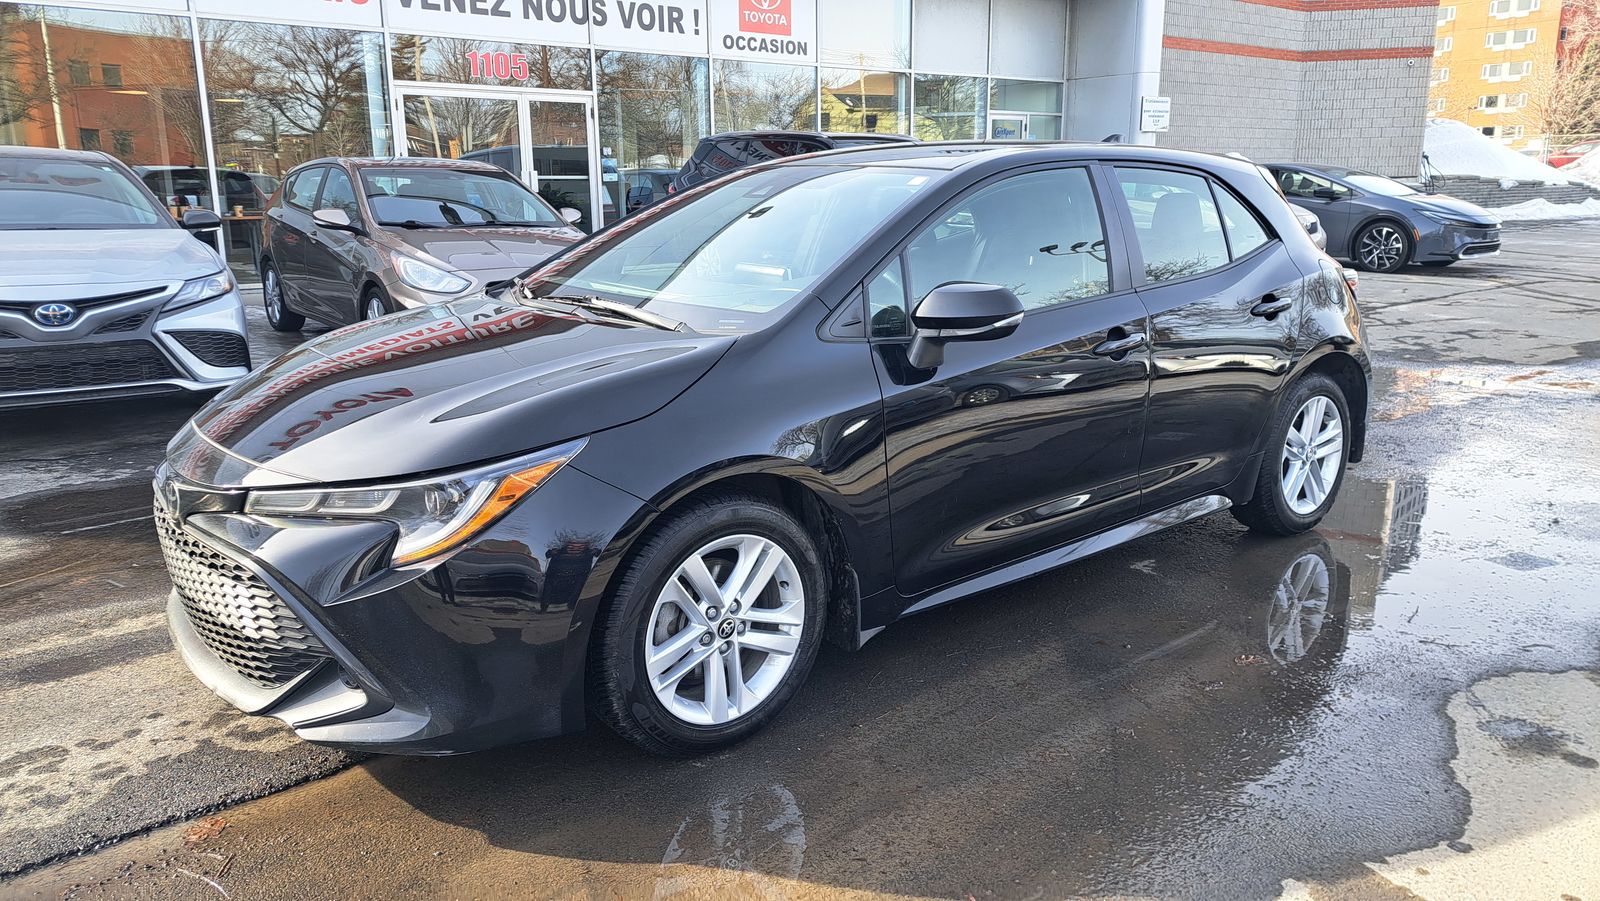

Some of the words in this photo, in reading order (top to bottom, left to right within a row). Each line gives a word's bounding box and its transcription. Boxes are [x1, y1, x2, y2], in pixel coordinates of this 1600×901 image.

[400, 0, 511, 18] NEZ
[522, 0, 608, 27] NOUS
[616, 1, 685, 35] VOIR
[693, 8, 700, 36] !
[743, 10, 788, 27] TOYOTA
[722, 34, 808, 56] OCCASION
[465, 49, 530, 80] 1105
